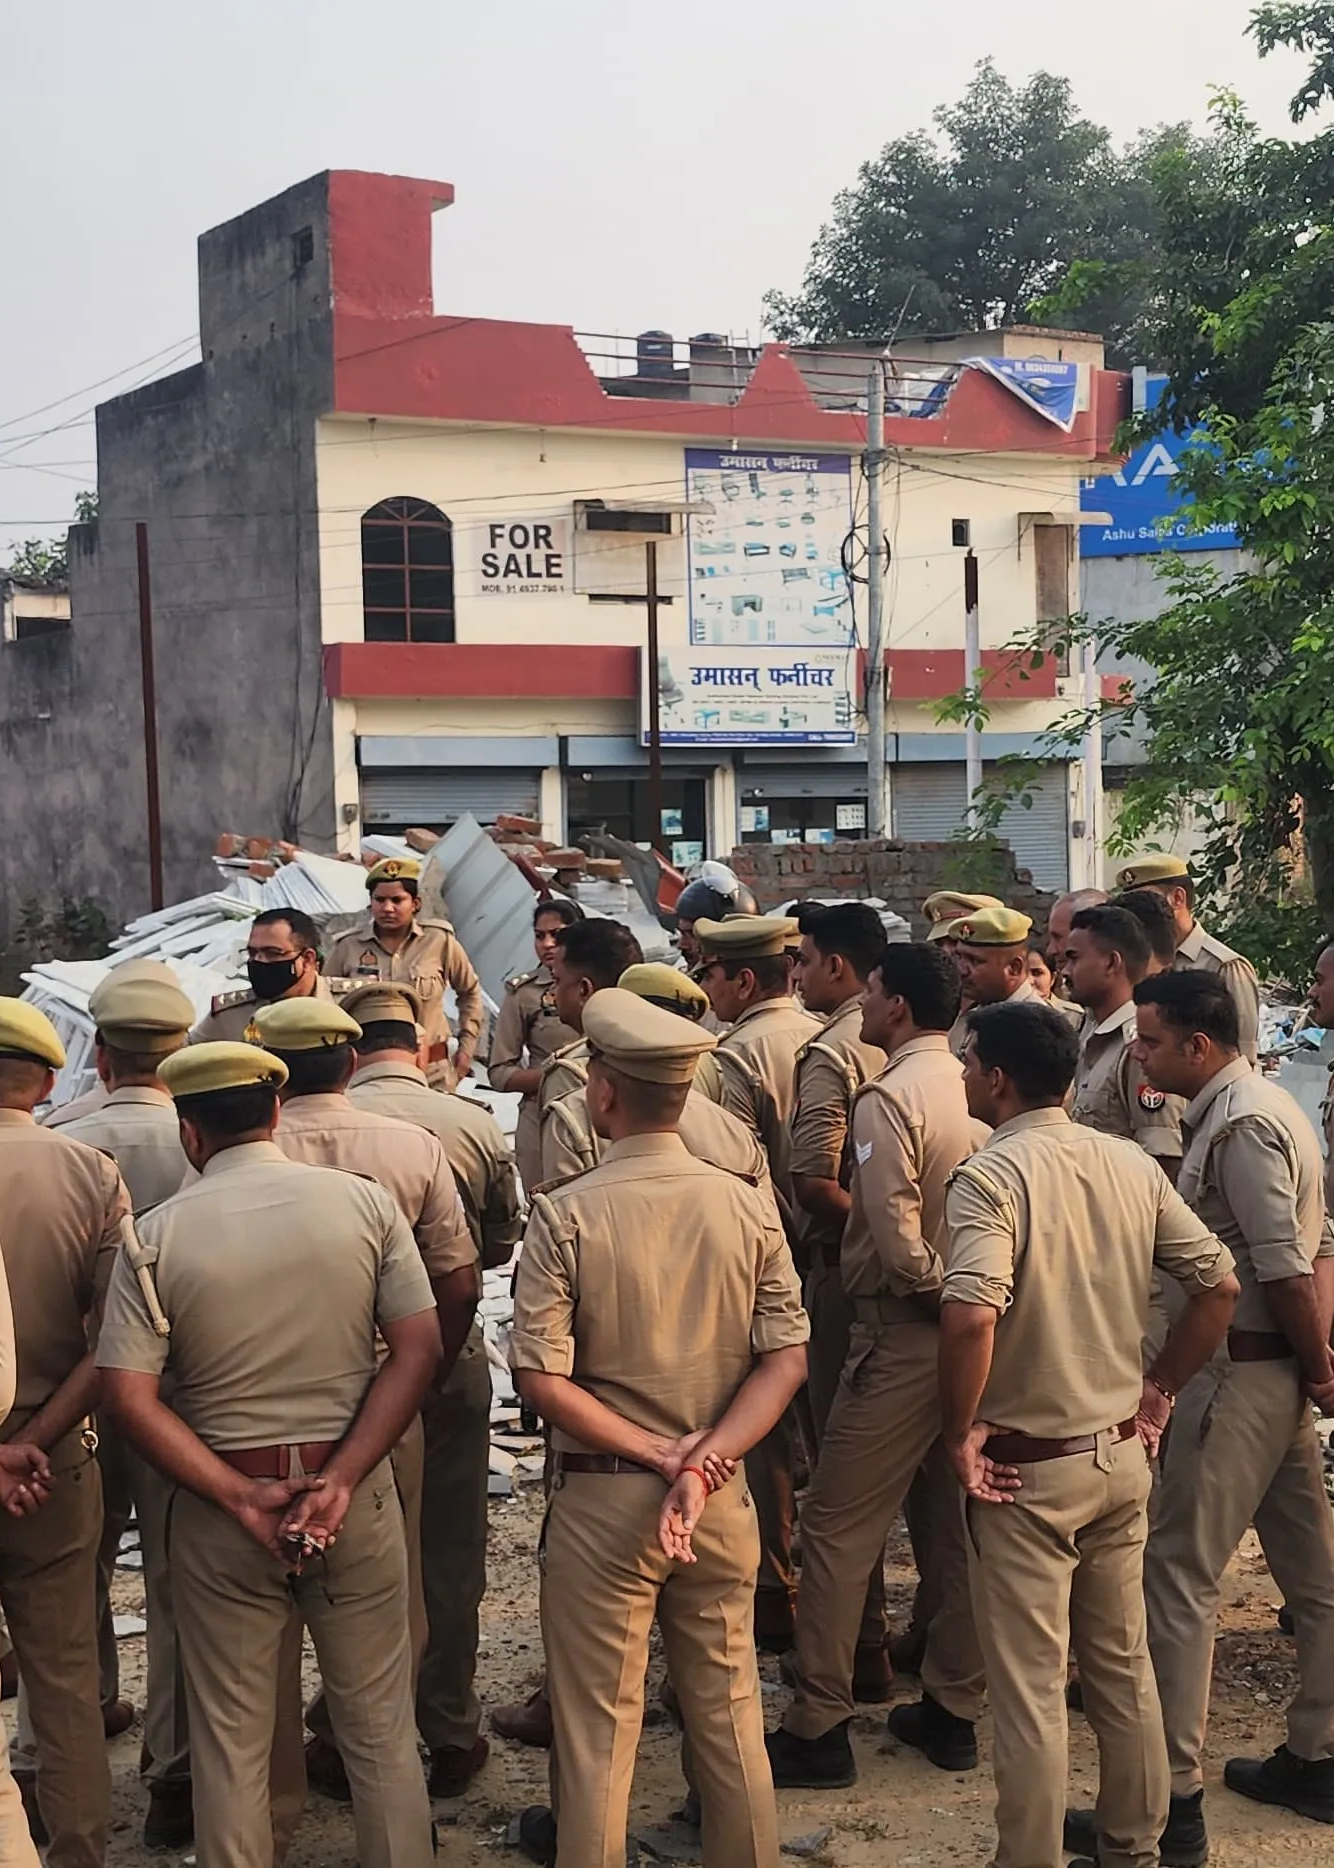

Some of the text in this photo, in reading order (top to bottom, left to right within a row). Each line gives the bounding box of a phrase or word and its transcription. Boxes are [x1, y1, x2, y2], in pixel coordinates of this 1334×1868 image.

[489, 523, 554, 550] FOR
[1102, 528, 1136, 541] Ashu
[481, 552, 563, 579] SALE
[689, 662, 836, 692] उमासन् फर्नीचर
